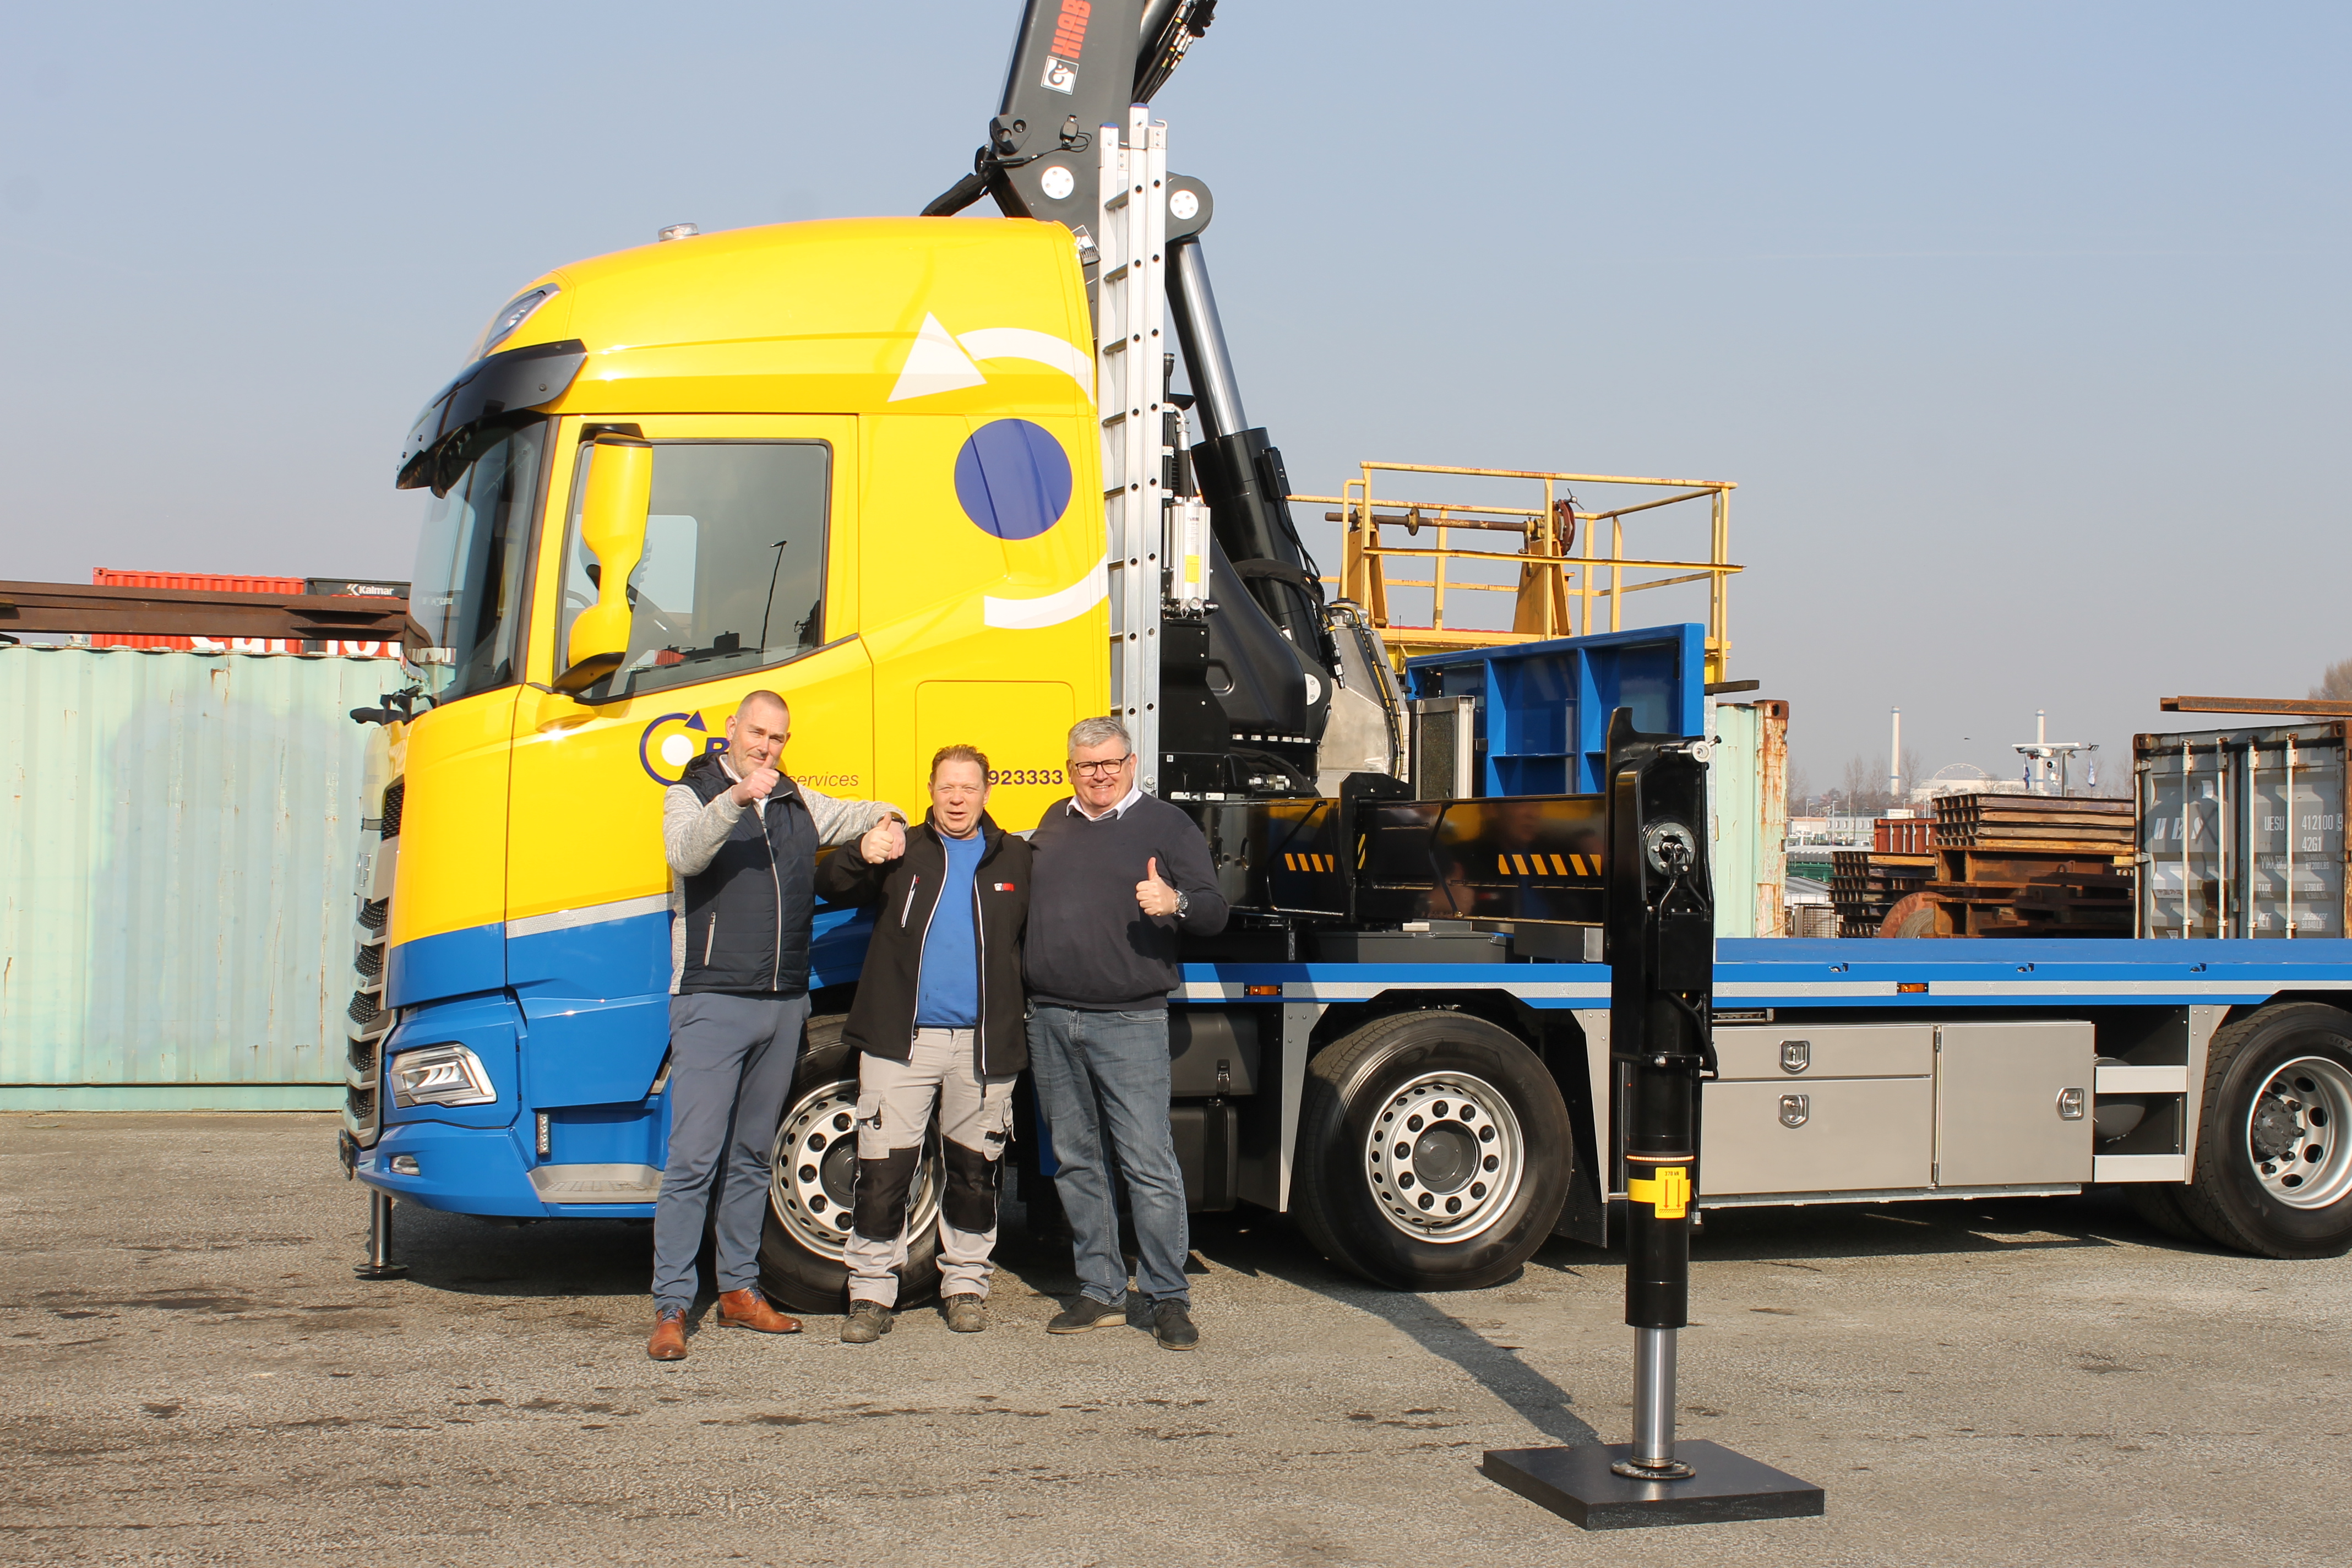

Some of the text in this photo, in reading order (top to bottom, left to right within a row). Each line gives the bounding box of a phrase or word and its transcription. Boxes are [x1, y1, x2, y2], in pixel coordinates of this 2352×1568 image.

[1051, 0, 1091, 59] HIAB
[358, 585, 395, 595] Kalmar
[989, 769, 1063, 785] 923333
[2264, 815, 2285, 831] UESU
[2301, 815, 2333, 830] 412100
[2301, 836, 2322, 852] 42G1
